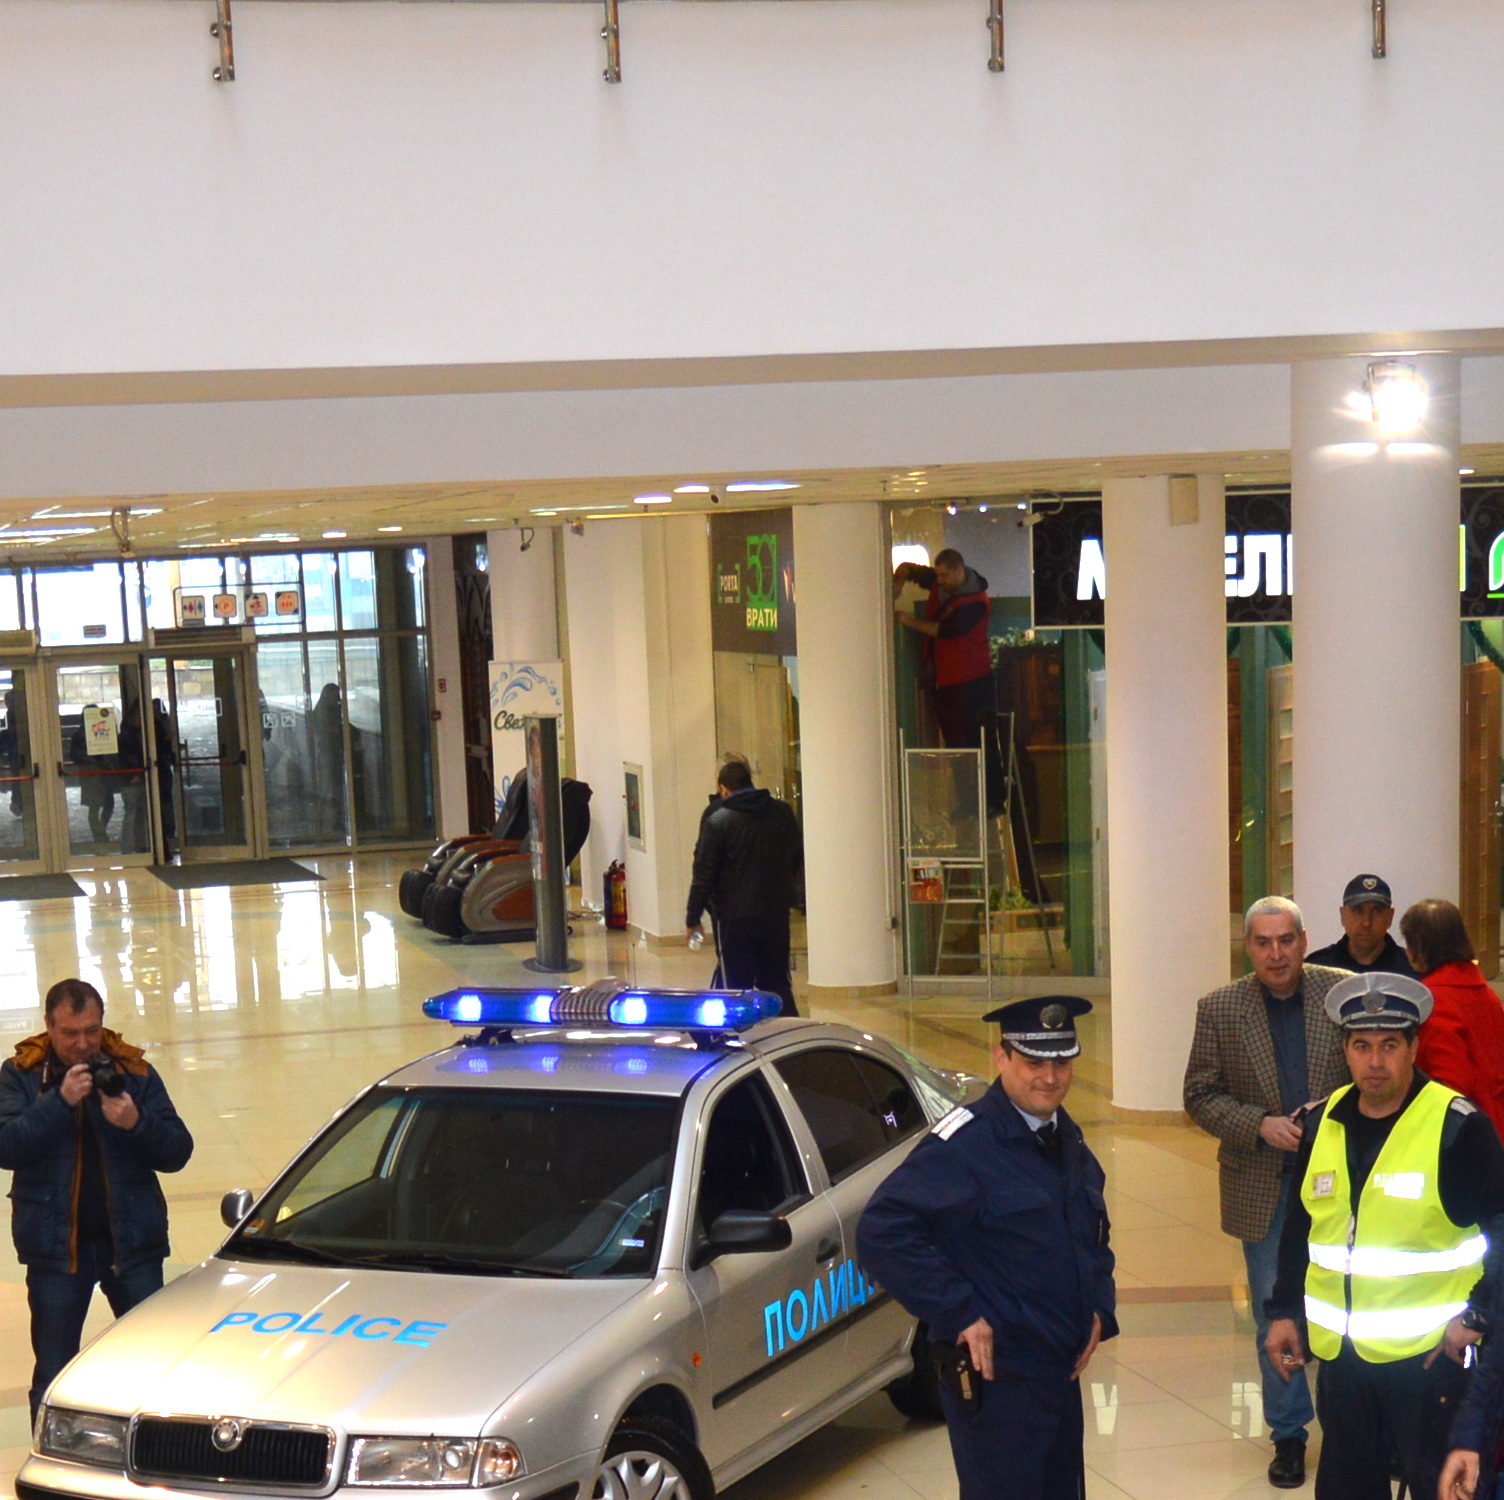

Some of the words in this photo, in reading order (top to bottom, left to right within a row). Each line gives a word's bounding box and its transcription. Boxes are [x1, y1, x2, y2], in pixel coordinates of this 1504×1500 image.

[746, 608, 778, 628] ВРАТИ
[764, 1258, 874, 1357] ПОЛИЦ
[209, 1312, 448, 1348] POLICE
